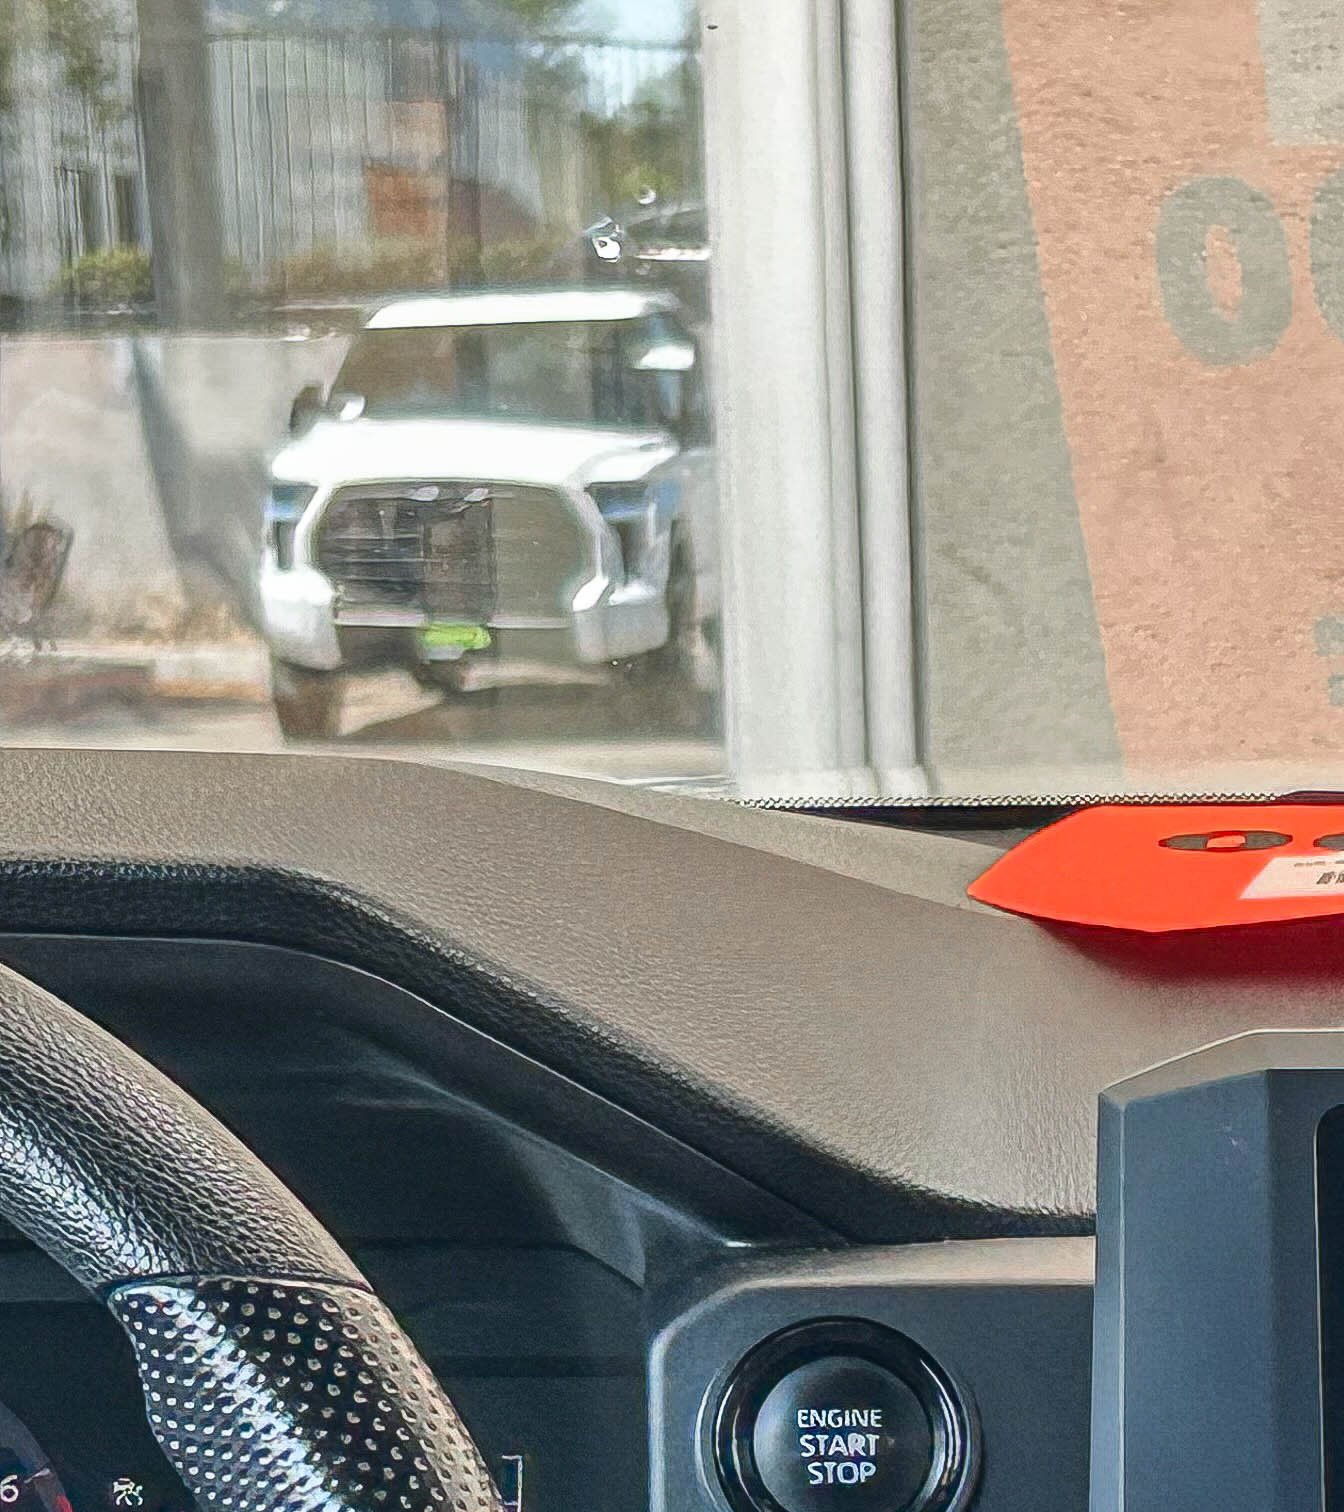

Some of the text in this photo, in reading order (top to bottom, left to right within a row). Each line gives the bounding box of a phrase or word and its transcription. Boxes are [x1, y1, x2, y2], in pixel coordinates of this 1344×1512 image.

[797, 1409, 883, 1428] ENGINE
[799, 1434, 880, 1457] START
[807, 1461, 876, 1485] STOP
[0, 1474, 19, 1503] 6
